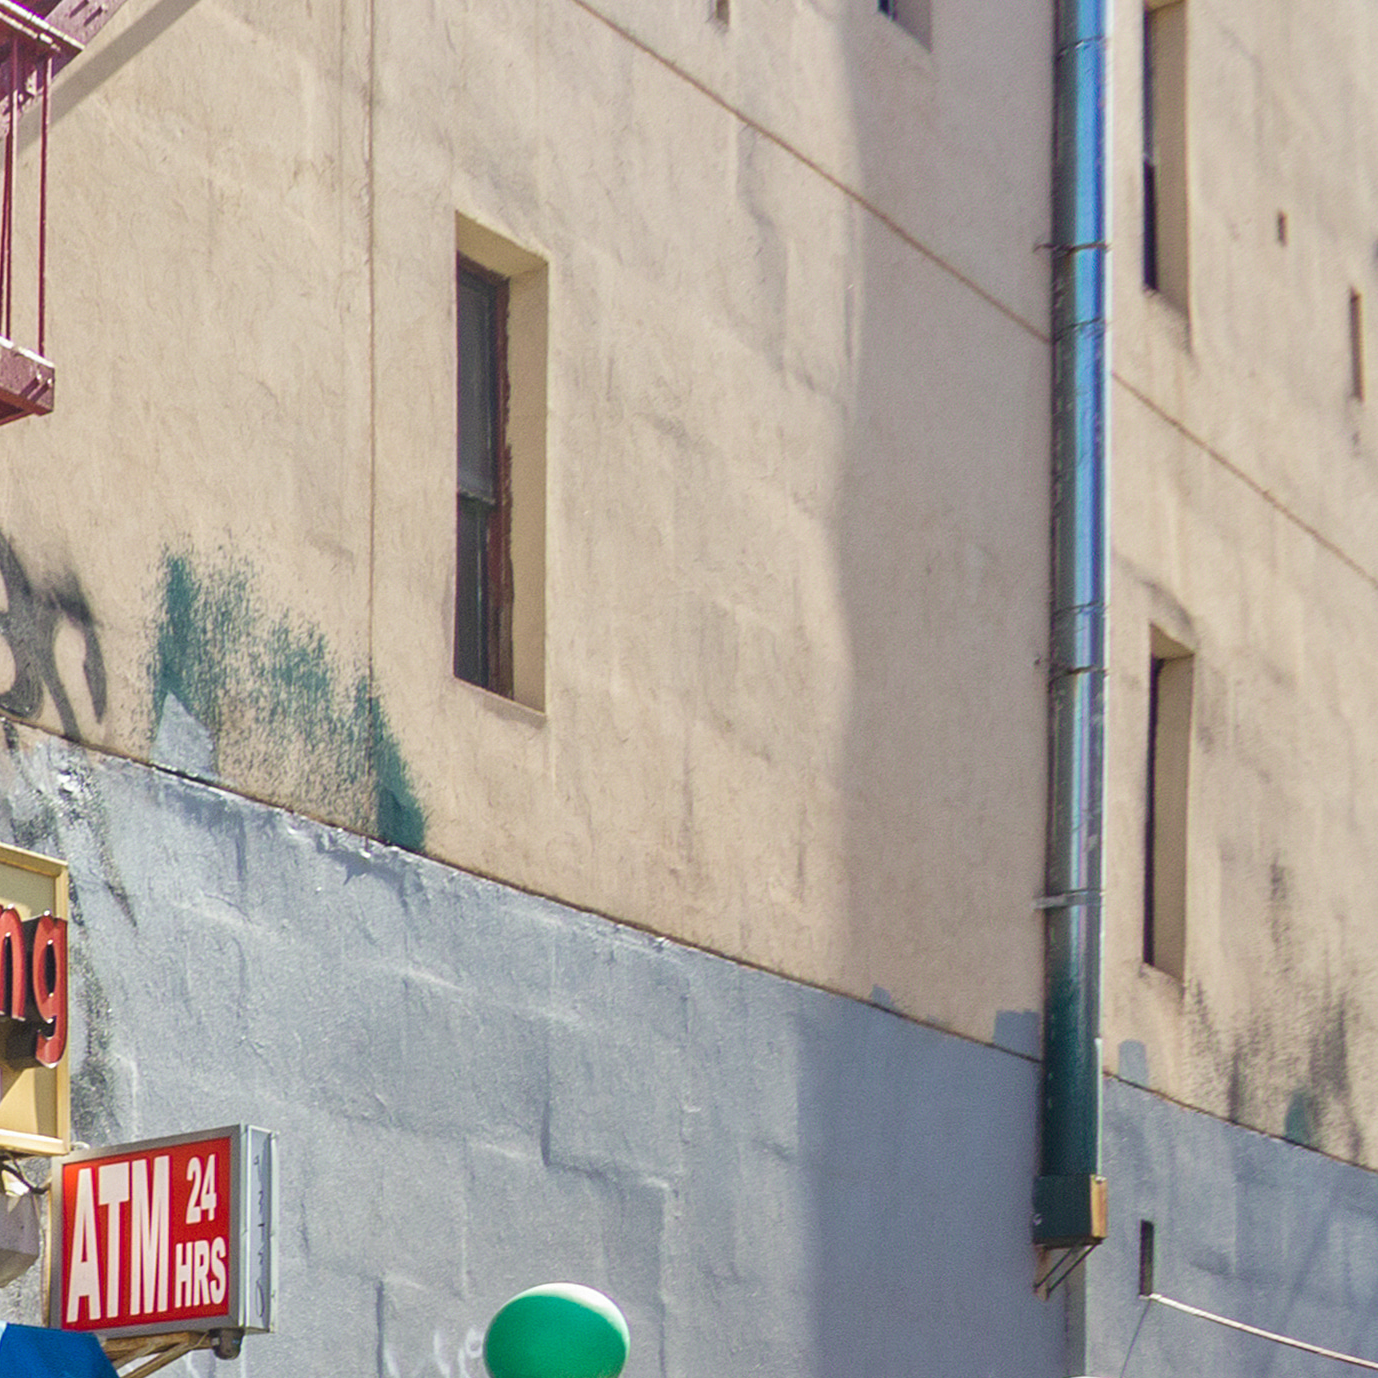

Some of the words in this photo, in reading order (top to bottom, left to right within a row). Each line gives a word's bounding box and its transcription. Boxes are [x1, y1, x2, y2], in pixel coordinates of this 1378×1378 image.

[67, 1154, 170, 1323] ATM
[186, 1153, 217, 1225] 24
[175, 1237, 226, 1308] HRS
